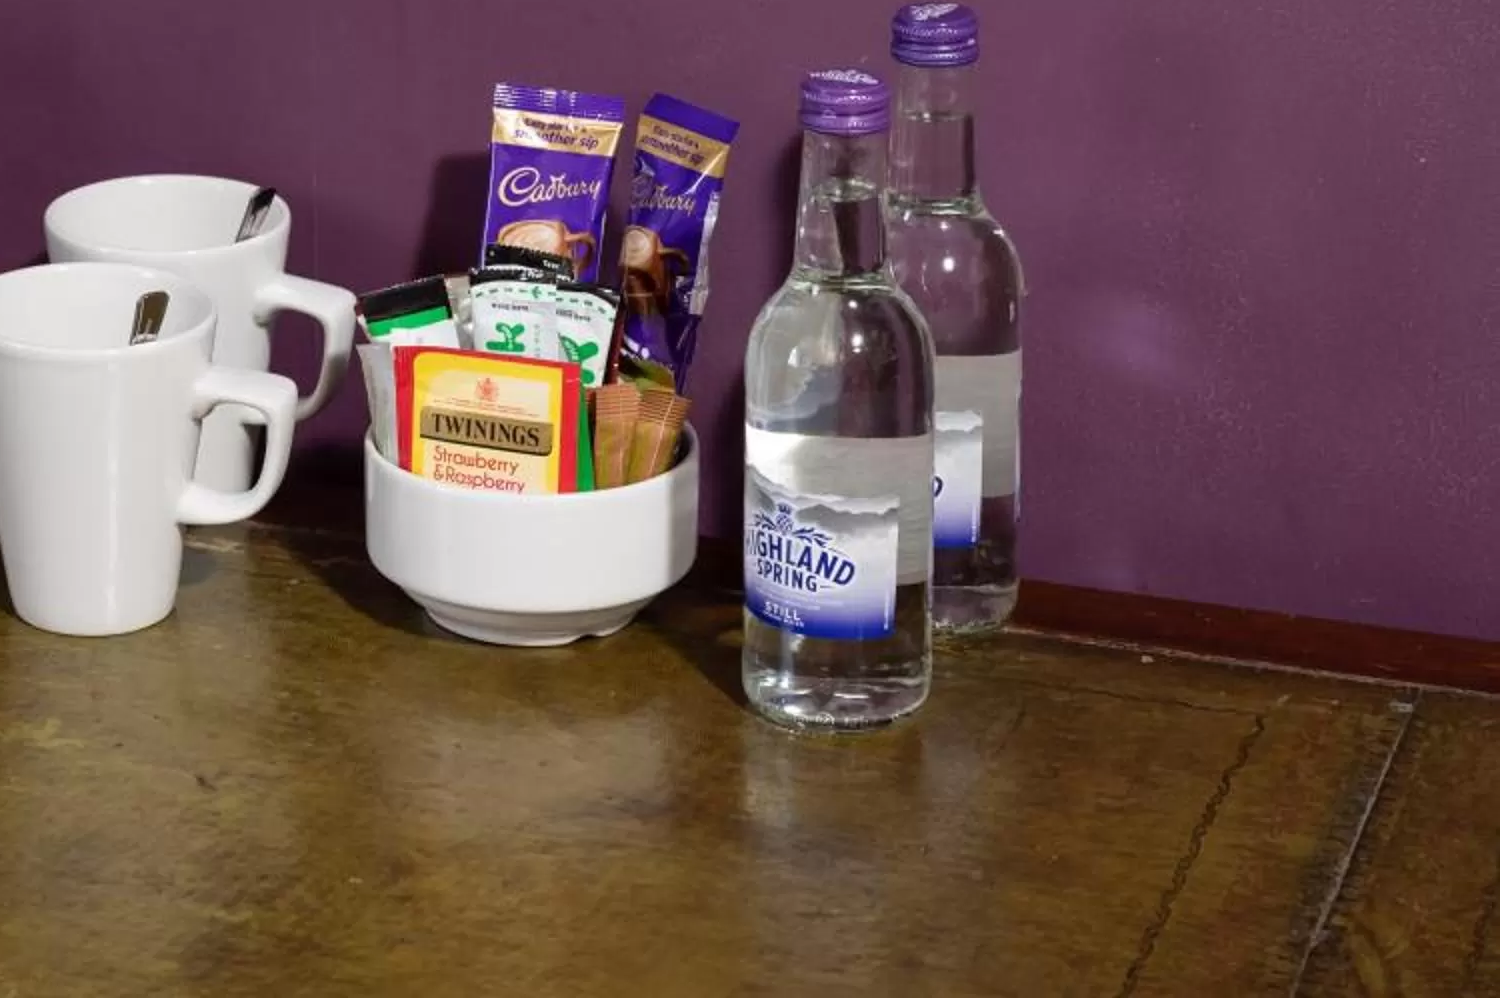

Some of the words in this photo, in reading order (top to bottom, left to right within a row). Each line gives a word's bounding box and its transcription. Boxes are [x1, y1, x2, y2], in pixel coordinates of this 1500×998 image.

[498, 166, 602, 207] Cadbury
[432, 412, 540, 448] TWININGS
[433, 445, 520, 476] Strawberry
[756, 558, 818, 593] SPRING
